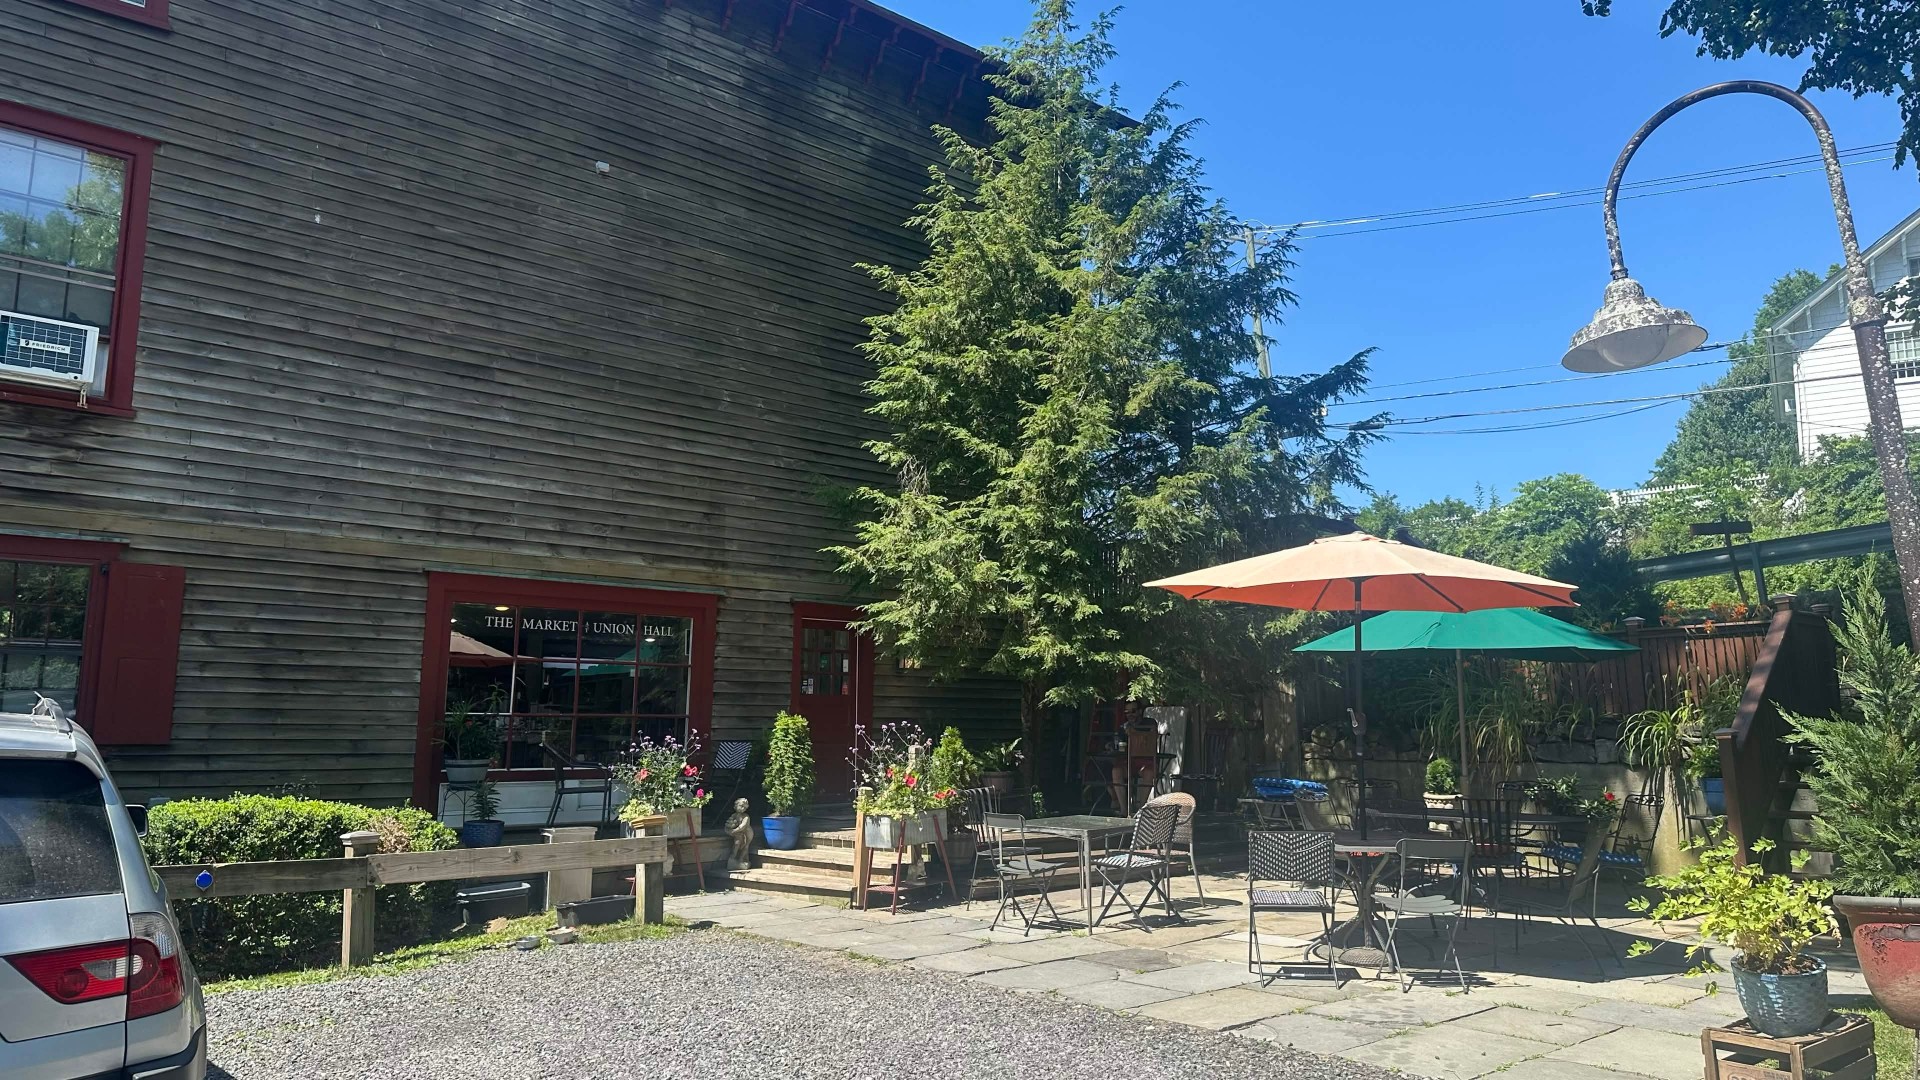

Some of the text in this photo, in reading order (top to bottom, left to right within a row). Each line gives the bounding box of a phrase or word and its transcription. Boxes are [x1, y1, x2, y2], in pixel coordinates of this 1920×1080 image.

[32, 342, 66, 351] FRIEDRICH
[485, 615, 513, 628] THE
[522, 618, 579, 632] MARKET
[593, 622, 635, 635] UNION
[643, 625, 674, 637] HALL
